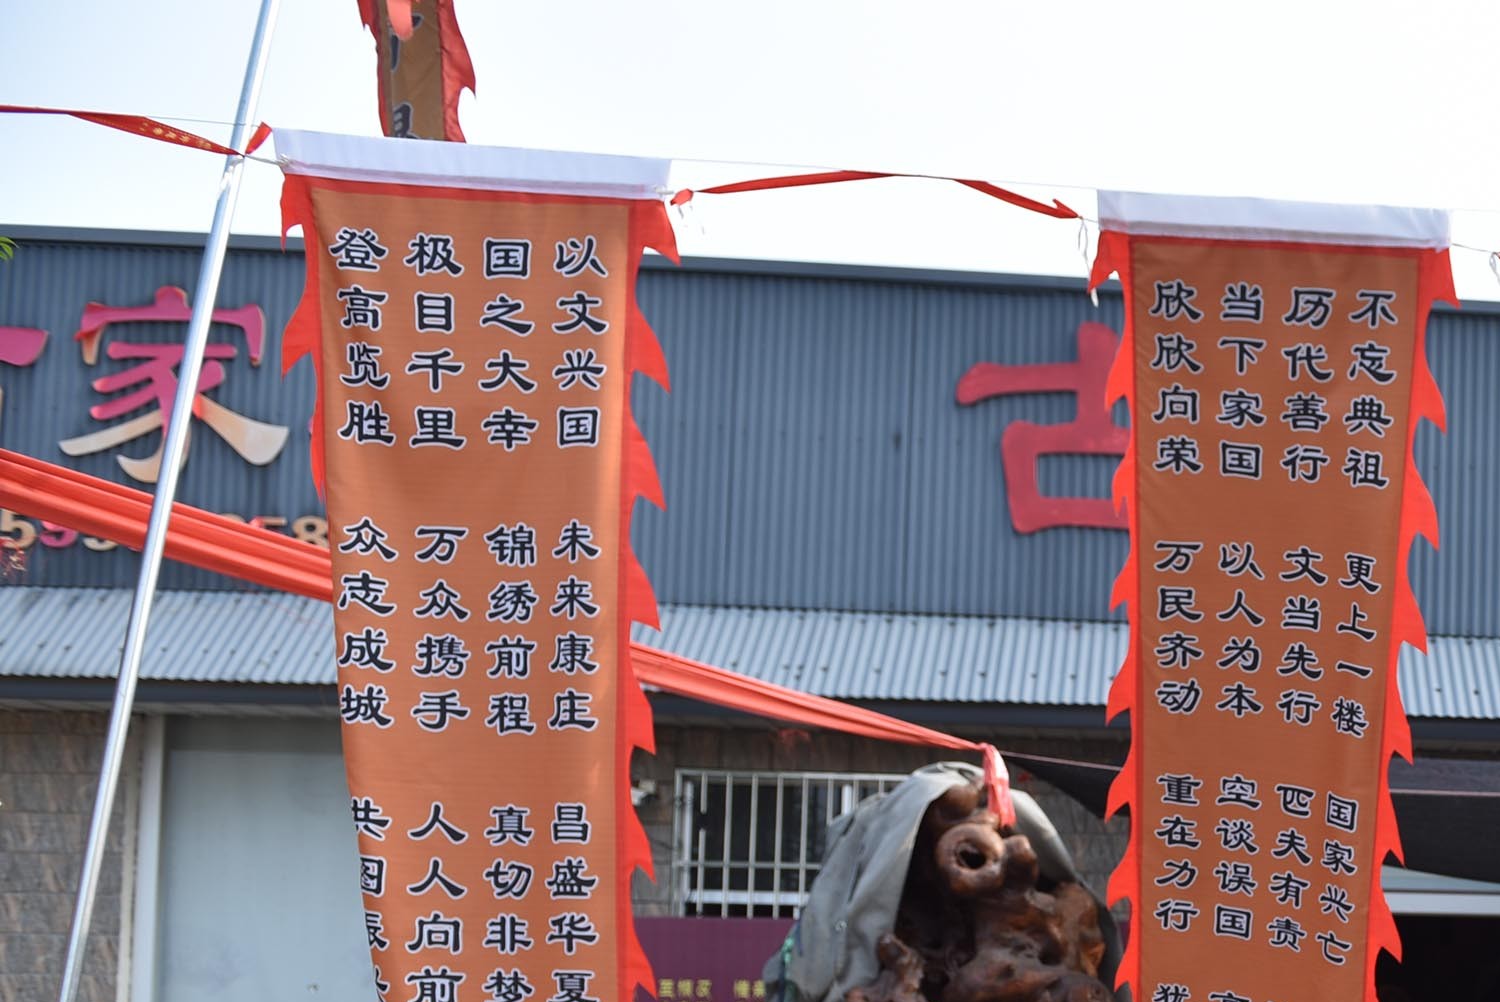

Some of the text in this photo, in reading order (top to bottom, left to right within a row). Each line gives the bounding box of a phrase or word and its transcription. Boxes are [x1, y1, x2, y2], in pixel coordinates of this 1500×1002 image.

[59, 286, 289, 483] 家
[327, 225, 398, 450] 登高览胜
[402, 231, 468, 451] 极目千里
[477, 235, 539, 453] 国之大幸
[550, 234, 609, 448] 以文兴国
[1149, 279, 1203, 475] 欣欣向荣
[1215, 282, 1266, 480] 当下家国
[1279, 285, 1336, 483] 历代善行
[1342, 289, 1398, 490] 不忘典祖
[337, 515, 399, 730] 众志成城
[410, 520, 471, 734] 万众携手
[482, 521, 538, 736] 锦绣前程
[546, 518, 600, 733] 未来康庄
[1152, 539, 1203, 715] 万民齐动
[1216, 541, 1265, 719] 以人为本
[1277, 546, 1328, 727] 文当先行
[1330, 551, 1381, 740] 更上一楼
[1152, 772, 1202, 934] 重在力行
[1212, 774, 1261, 940] 空谈误国
[1267, 782, 1317, 953] 匹夫有责
[1315, 791, 1360, 967] 国家兴亡
